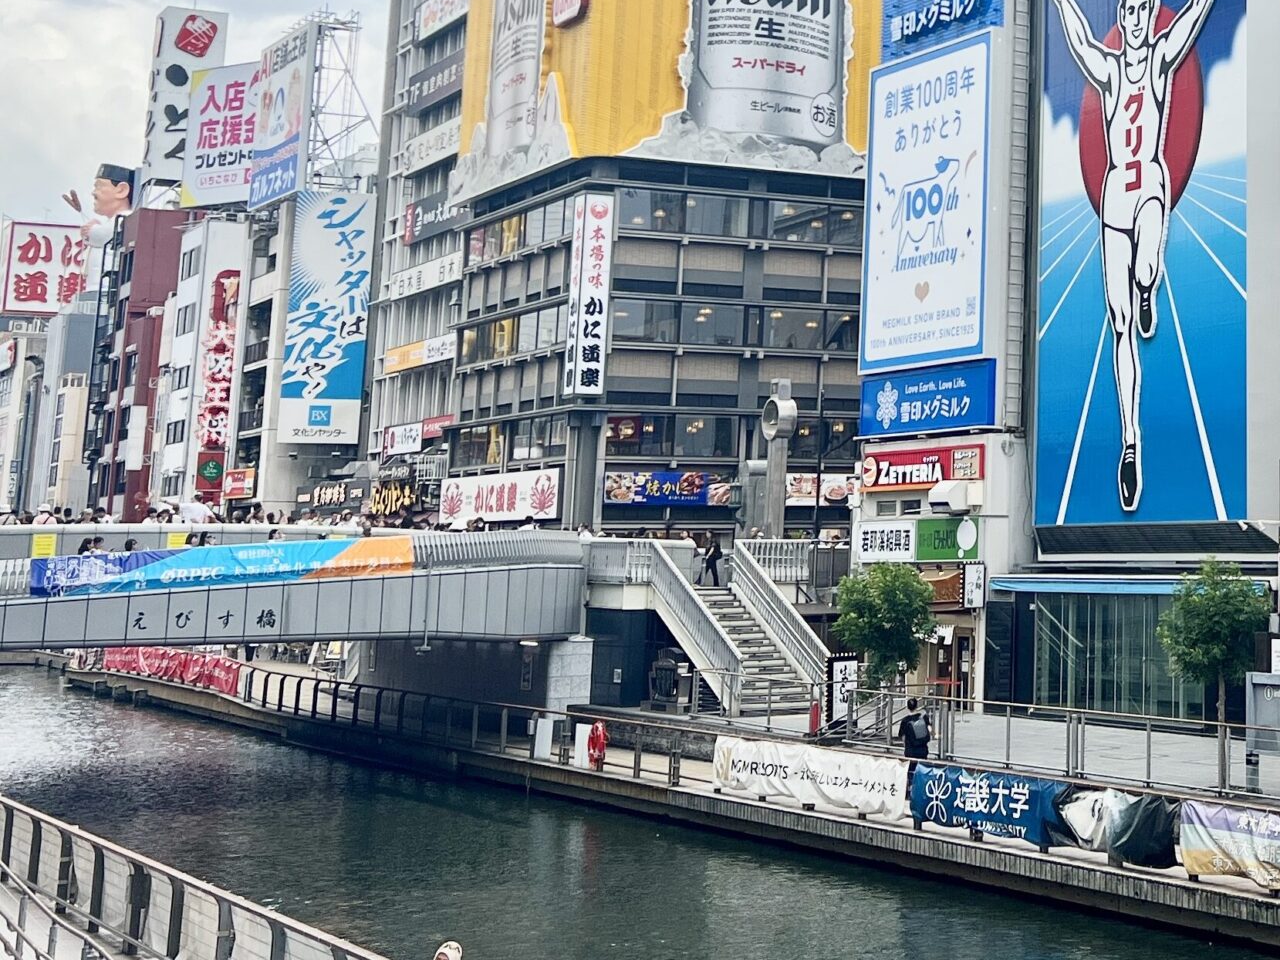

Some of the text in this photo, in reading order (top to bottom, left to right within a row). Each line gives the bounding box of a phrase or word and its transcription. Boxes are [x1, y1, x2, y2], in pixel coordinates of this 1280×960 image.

[755, 17, 786, 41] 生
[732, 57, 806, 76] スーパードライ
[200, 81, 246, 115] 入店
[884, 66, 975, 118] 創業100周年
[895, 109, 961, 153] ありがとう
[1124, 86, 1145, 192] グリコ
[251, 161, 294, 203] ガルフネット
[906, 184, 959, 221] 100th
[17, 232, 86, 266] かに
[588, 225, 606, 289] 本場の味
[892, 247, 958, 273] Anniversary
[882, 308, 960, 329] MEGMILK SNOW BRAND
[580, 296, 604, 388] かに道楽
[905, 377, 967, 394] Love Earth. Love Life.
[311, 410, 328, 421] BX
[900, 395, 971, 423] 雪印メグミルク
[292, 428, 347, 438] 文化シャッター
[878, 461, 943, 486] ZETTERIA
[474, 481, 517, 513] かに道楽
[133, 609, 276, 630] えびす橋
